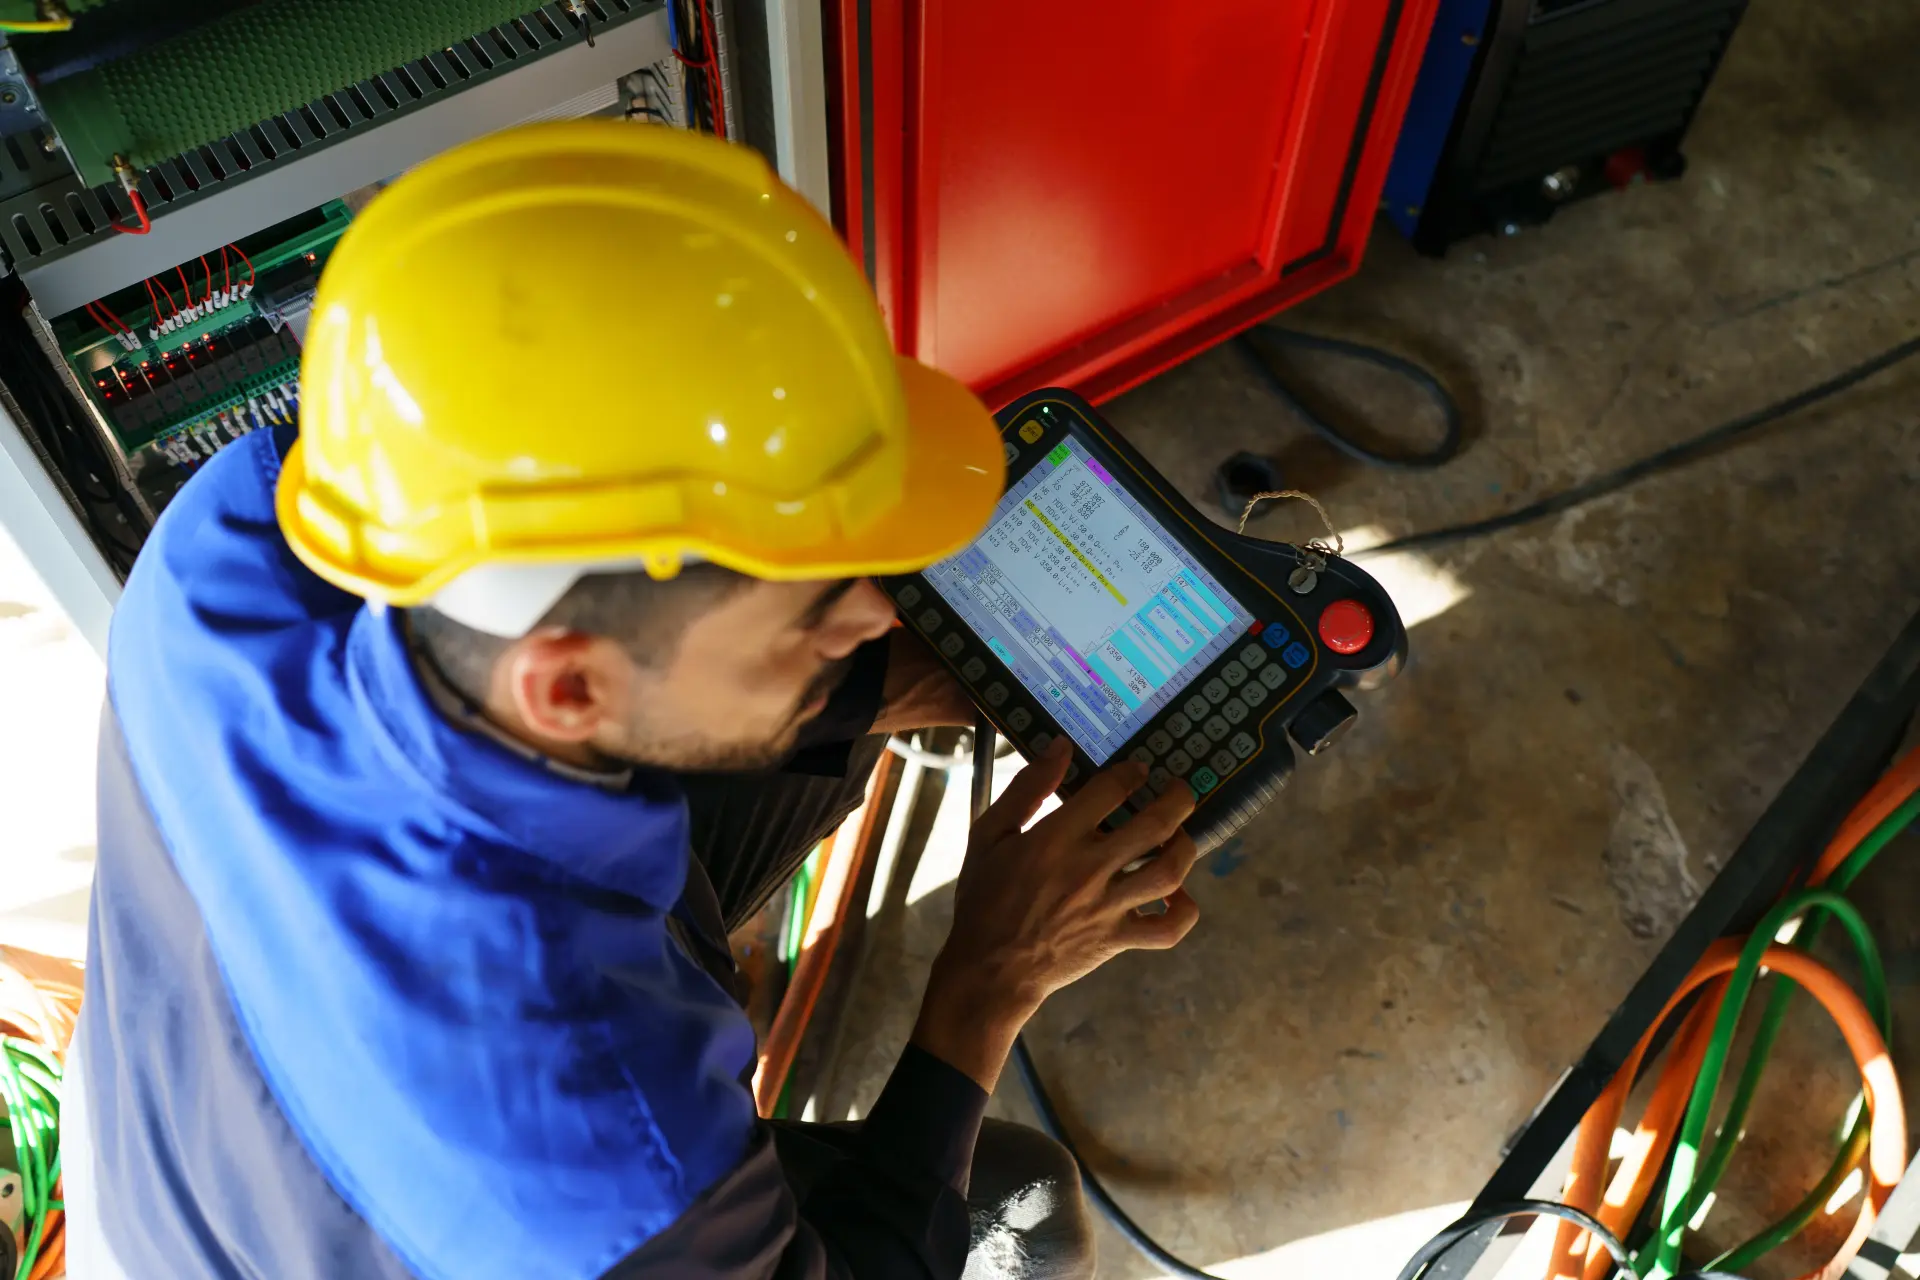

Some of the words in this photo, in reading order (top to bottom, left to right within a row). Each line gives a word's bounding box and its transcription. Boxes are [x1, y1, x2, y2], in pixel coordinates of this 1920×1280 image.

[1039, 485, 1050, 495] N6
[1051, 498, 1068, 514] MOVJ
[1051, 481, 1062, 491] XS
[1070, 500, 1090, 520] 5.836
[1068, 489, 1095, 515] 902.004
[1071, 481, 1100, 510] -417.247
[1078, 479, 1105, 506] 973.907
[1024, 499, 1035, 509] N8
[1036, 512, 1053, 528] MOVJ
[1032, 492, 1042, 502] N7
[1044, 505, 1060, 521] MOVJ
[1009, 513, 1023, 527] N10
[1024, 529, 1041, 545] MOVL
[1017, 506, 1027, 516] N9
[1029, 519, 1045, 535] MOVJ
[1117, 528, 1125, 536] B
[986, 534, 1000, 548] N13
[994, 527, 1008, 541] N12
[1006, 539, 1020, 554] M20
[1001, 520, 1015, 533] N11
[1016, 536, 1033, 552] MOVL
[1112, 533, 1120, 541] C
[1126, 547, 1153, 574] -23.193
[1136, 537, 1163, 565] 180.000
[979, 569, 996, 586] V350
[999, 590, 1020, 611] X130%
[1174, 575, 1188, 589] 147
[968, 584, 985, 601] MOVJ
[983, 600, 997, 615] G53
[992, 596, 1013, 618] X110%
[1105, 644, 1123, 662] V350
[1127, 667, 1148, 689] X130%
[1225, 666, 1241, 681] -2
[1099, 682, 1124, 709] N00008
[1127, 680, 1142, 695] 30%
[1205, 683, 1221, 699] -3
[1244, 685, 1260, 701] +2
[1108, 707, 1123, 722] 30%
